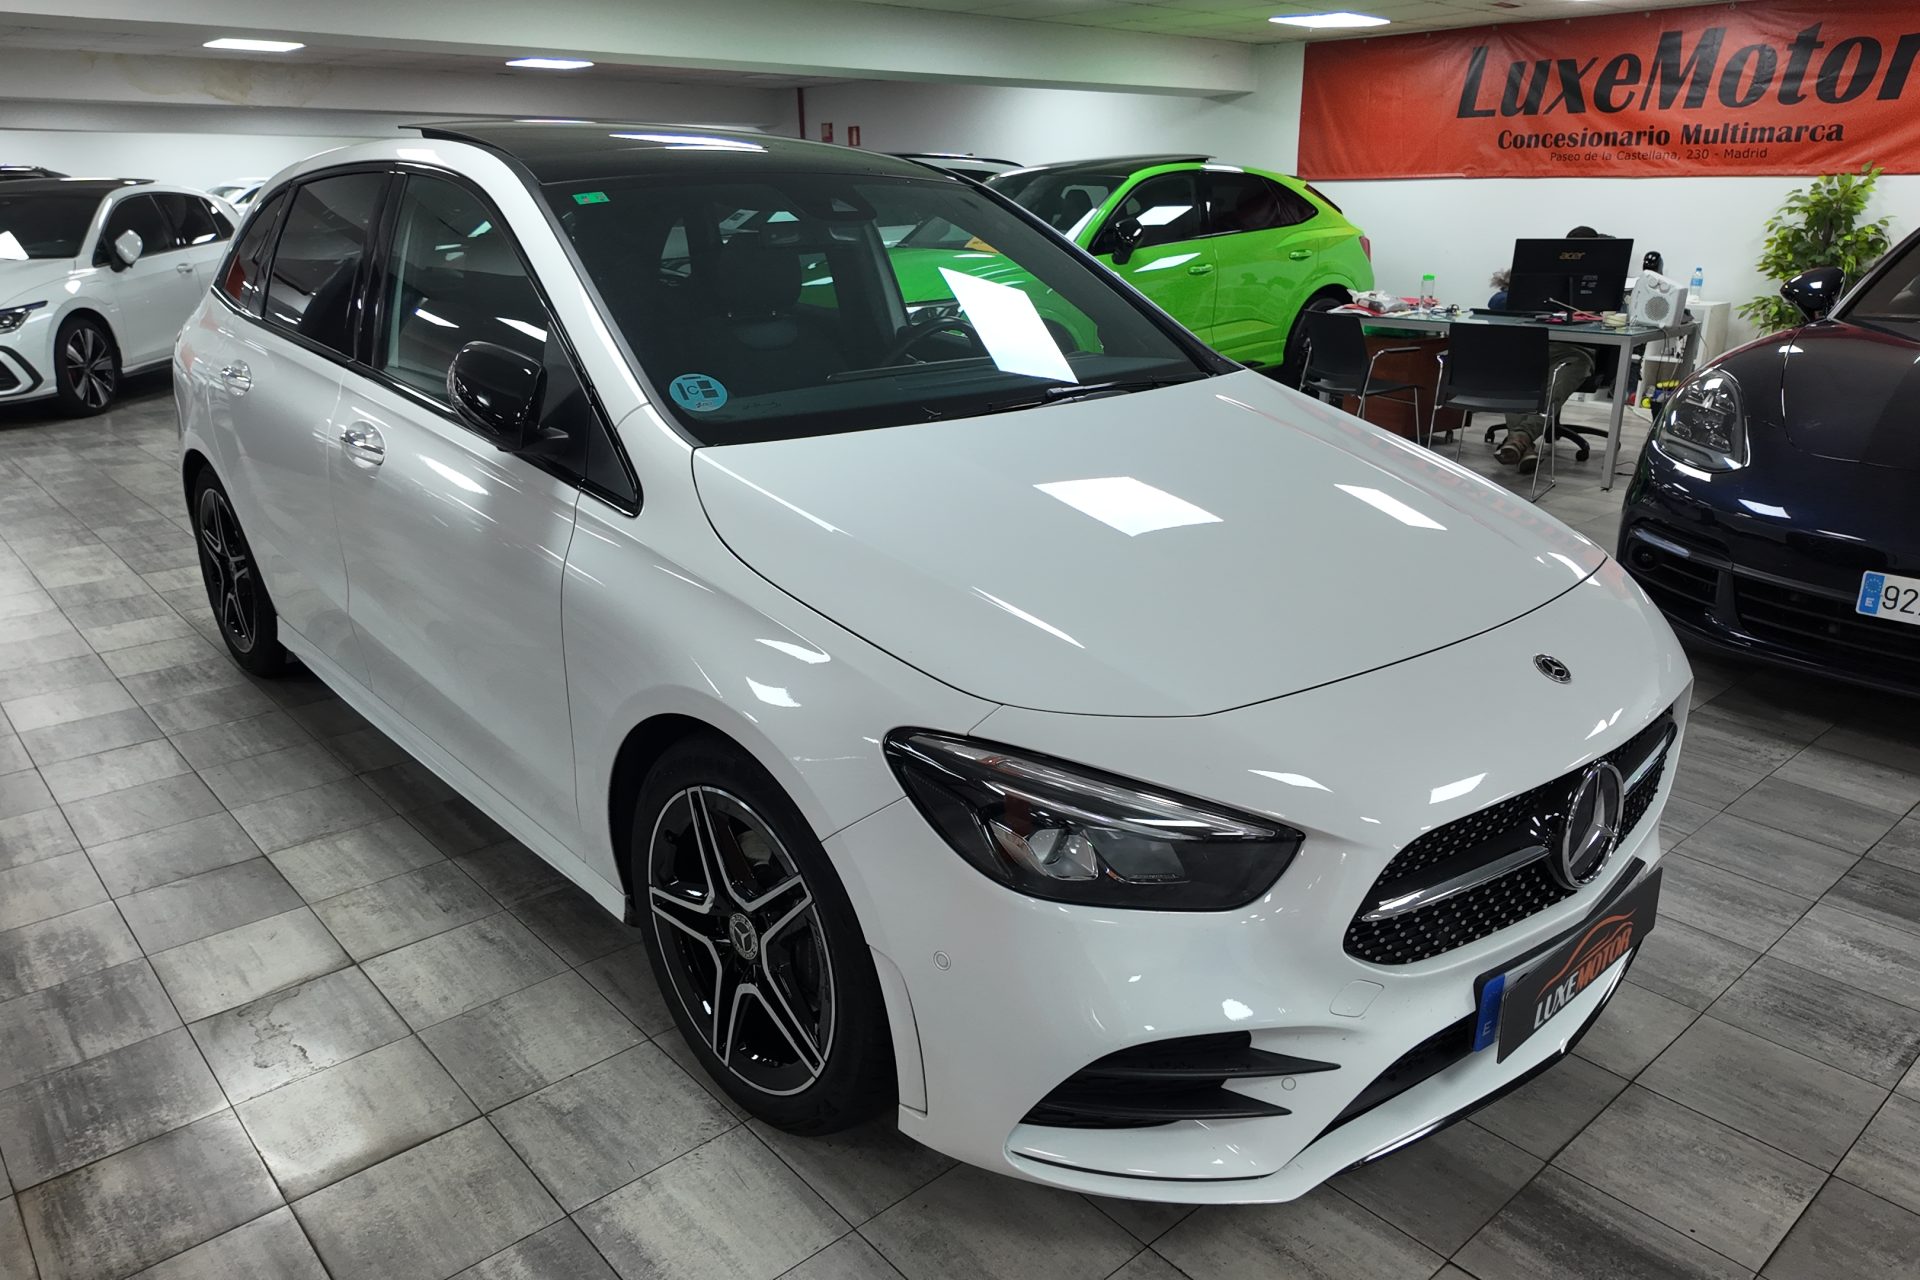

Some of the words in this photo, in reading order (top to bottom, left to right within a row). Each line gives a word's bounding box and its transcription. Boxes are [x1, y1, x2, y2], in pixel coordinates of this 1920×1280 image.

[1456, 21, 1920, 119] LuxeMotor
[1497, 125, 1670, 149] Concesionario
[1680, 122, 1844, 145] Multimarca
[1550, 152, 1581, 162] Paseo
[1584, 152, 1598, 161] de
[1601, 151, 1612, 161] la
[1616, 150, 1681, 161] Castellana,
[1686, 149, 1710, 160] 230
[1723, 148, 1768, 159] Madrid
[1559, 251, 1586, 260] acer
[1864, 597, 1875, 608] E
[1882, 585, 1920, 617] 92
[1533, 926, 1633, 1030] LUXEMOTOR
[1481, 1020, 1492, 1037] E
